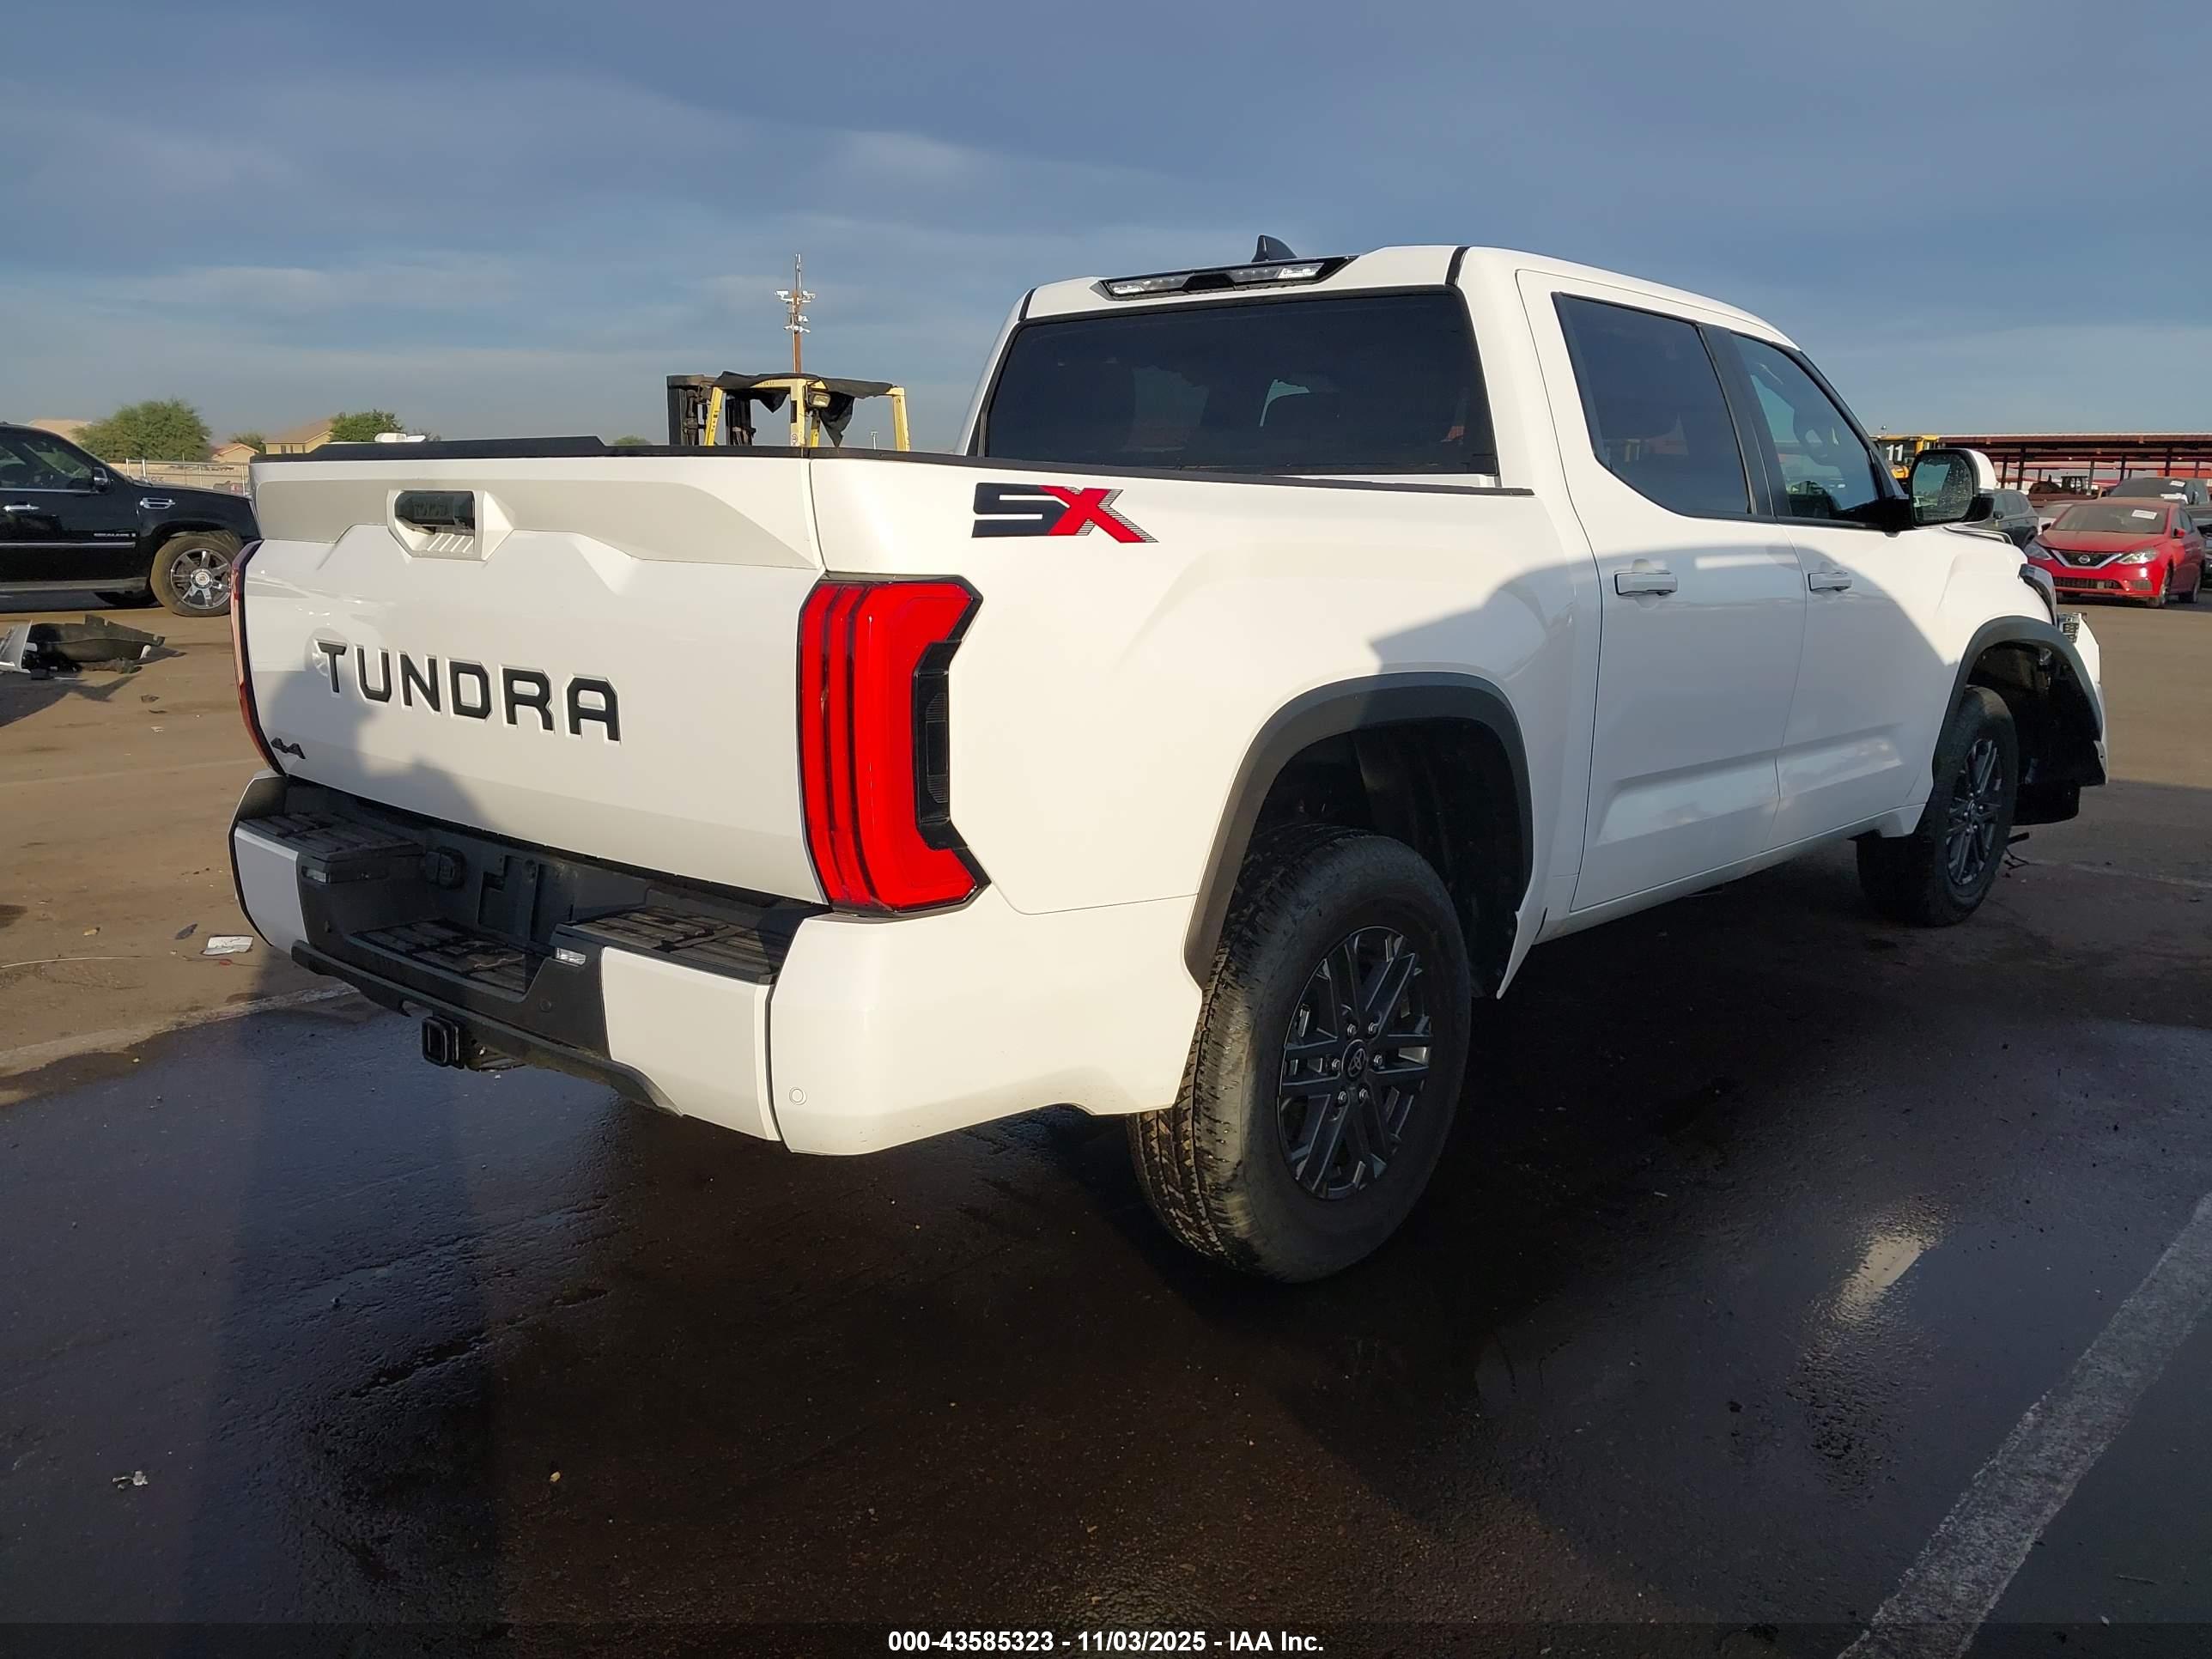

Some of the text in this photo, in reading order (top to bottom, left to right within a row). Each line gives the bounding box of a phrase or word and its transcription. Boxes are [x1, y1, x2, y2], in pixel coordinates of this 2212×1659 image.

[1886, 444, 1904, 461] 11
[972, 483, 1159, 544] SX
[314, 640, 621, 744] TUNDRA
